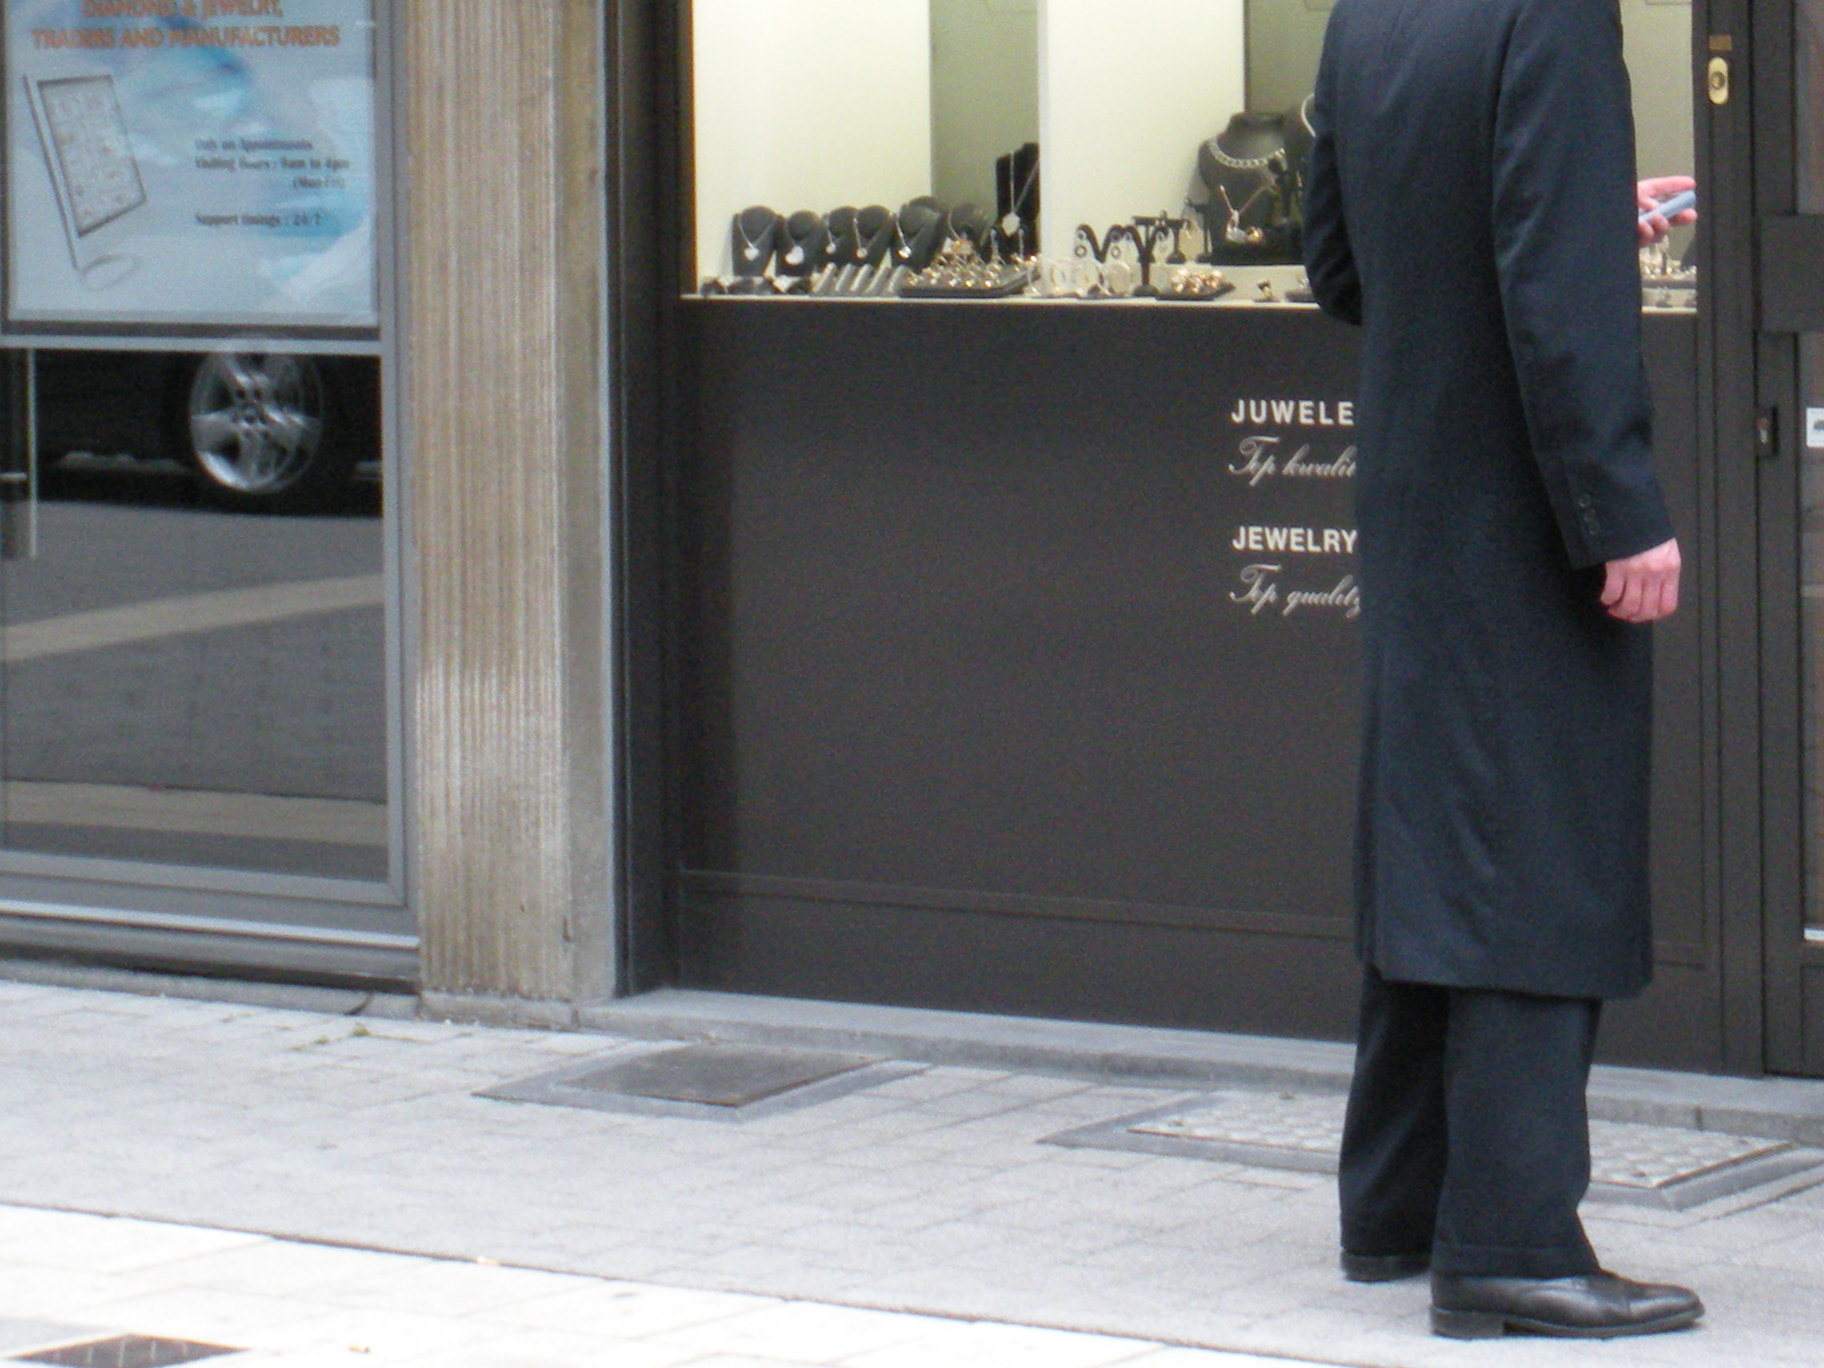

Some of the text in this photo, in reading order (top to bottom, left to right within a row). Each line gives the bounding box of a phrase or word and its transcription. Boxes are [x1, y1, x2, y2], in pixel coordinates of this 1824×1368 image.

[119, 27, 164, 48] AND
[1231, 399, 1355, 426] JUWELE
[1232, 525, 1358, 554] JEWELRY
[1283, 574, 1361, 618] quality
